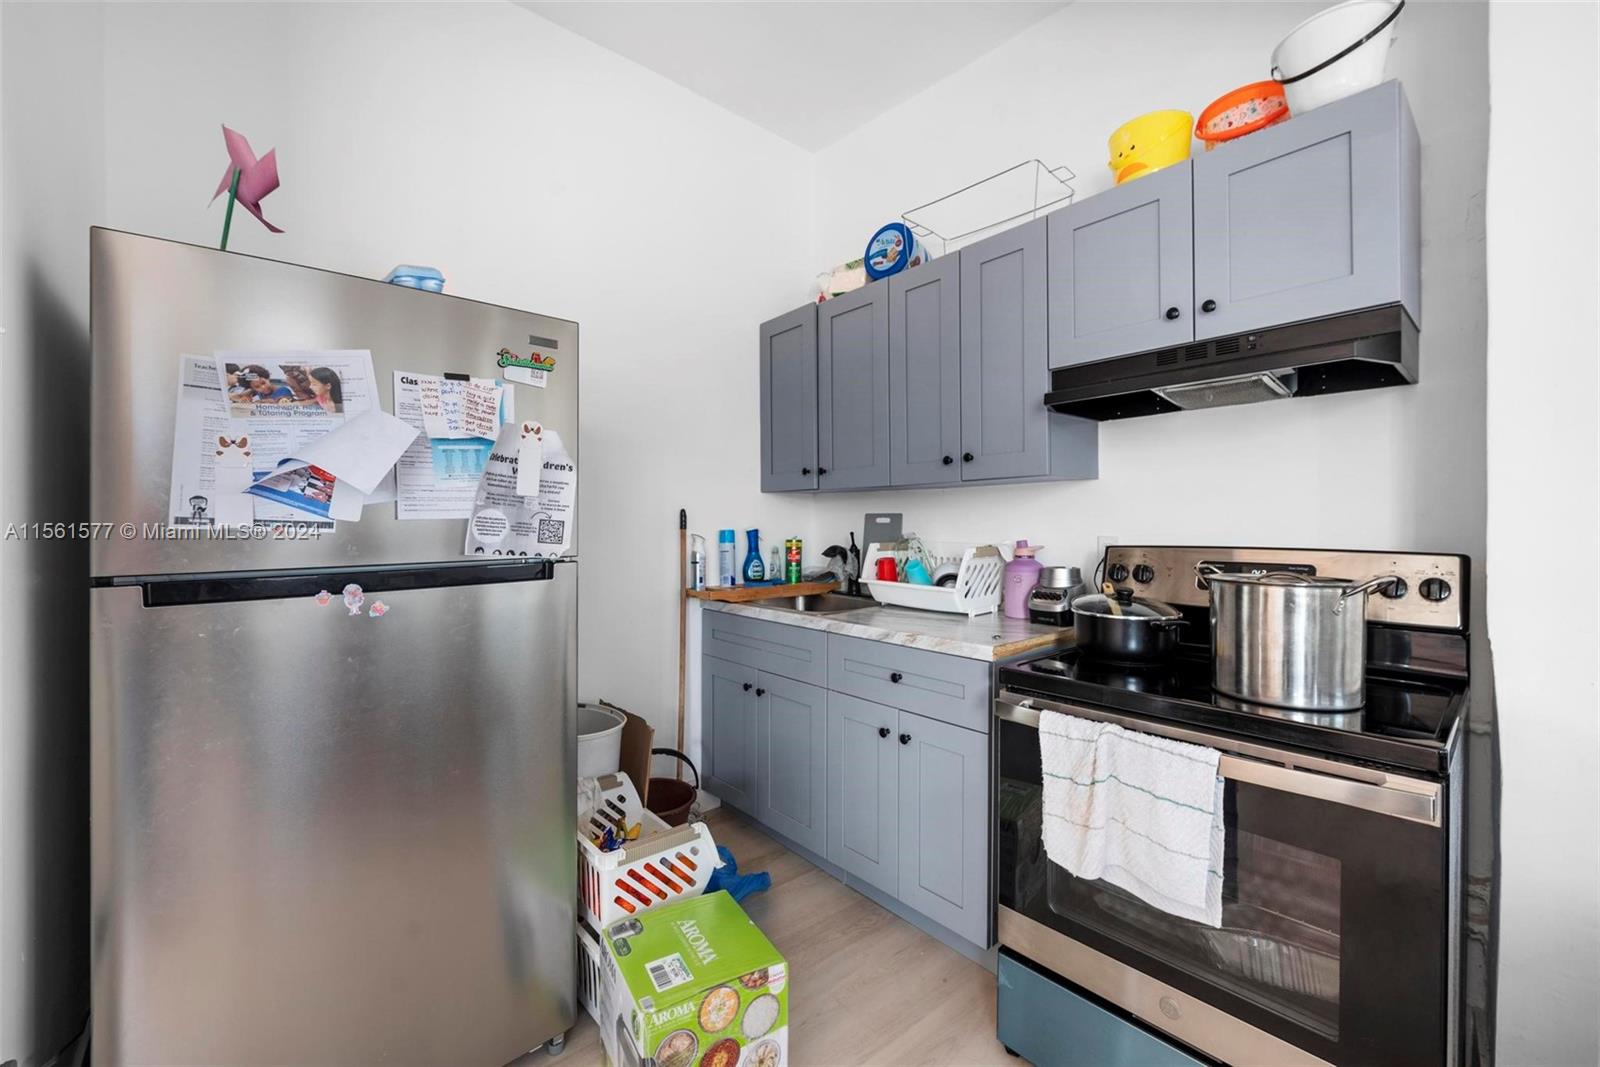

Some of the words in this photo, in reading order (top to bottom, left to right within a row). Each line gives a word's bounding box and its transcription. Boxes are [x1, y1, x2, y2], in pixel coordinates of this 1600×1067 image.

[543, 461, 574, 472] dren's
[677, 919, 719, 966] AROMA
[650, 1001, 696, 1027] AROMA
